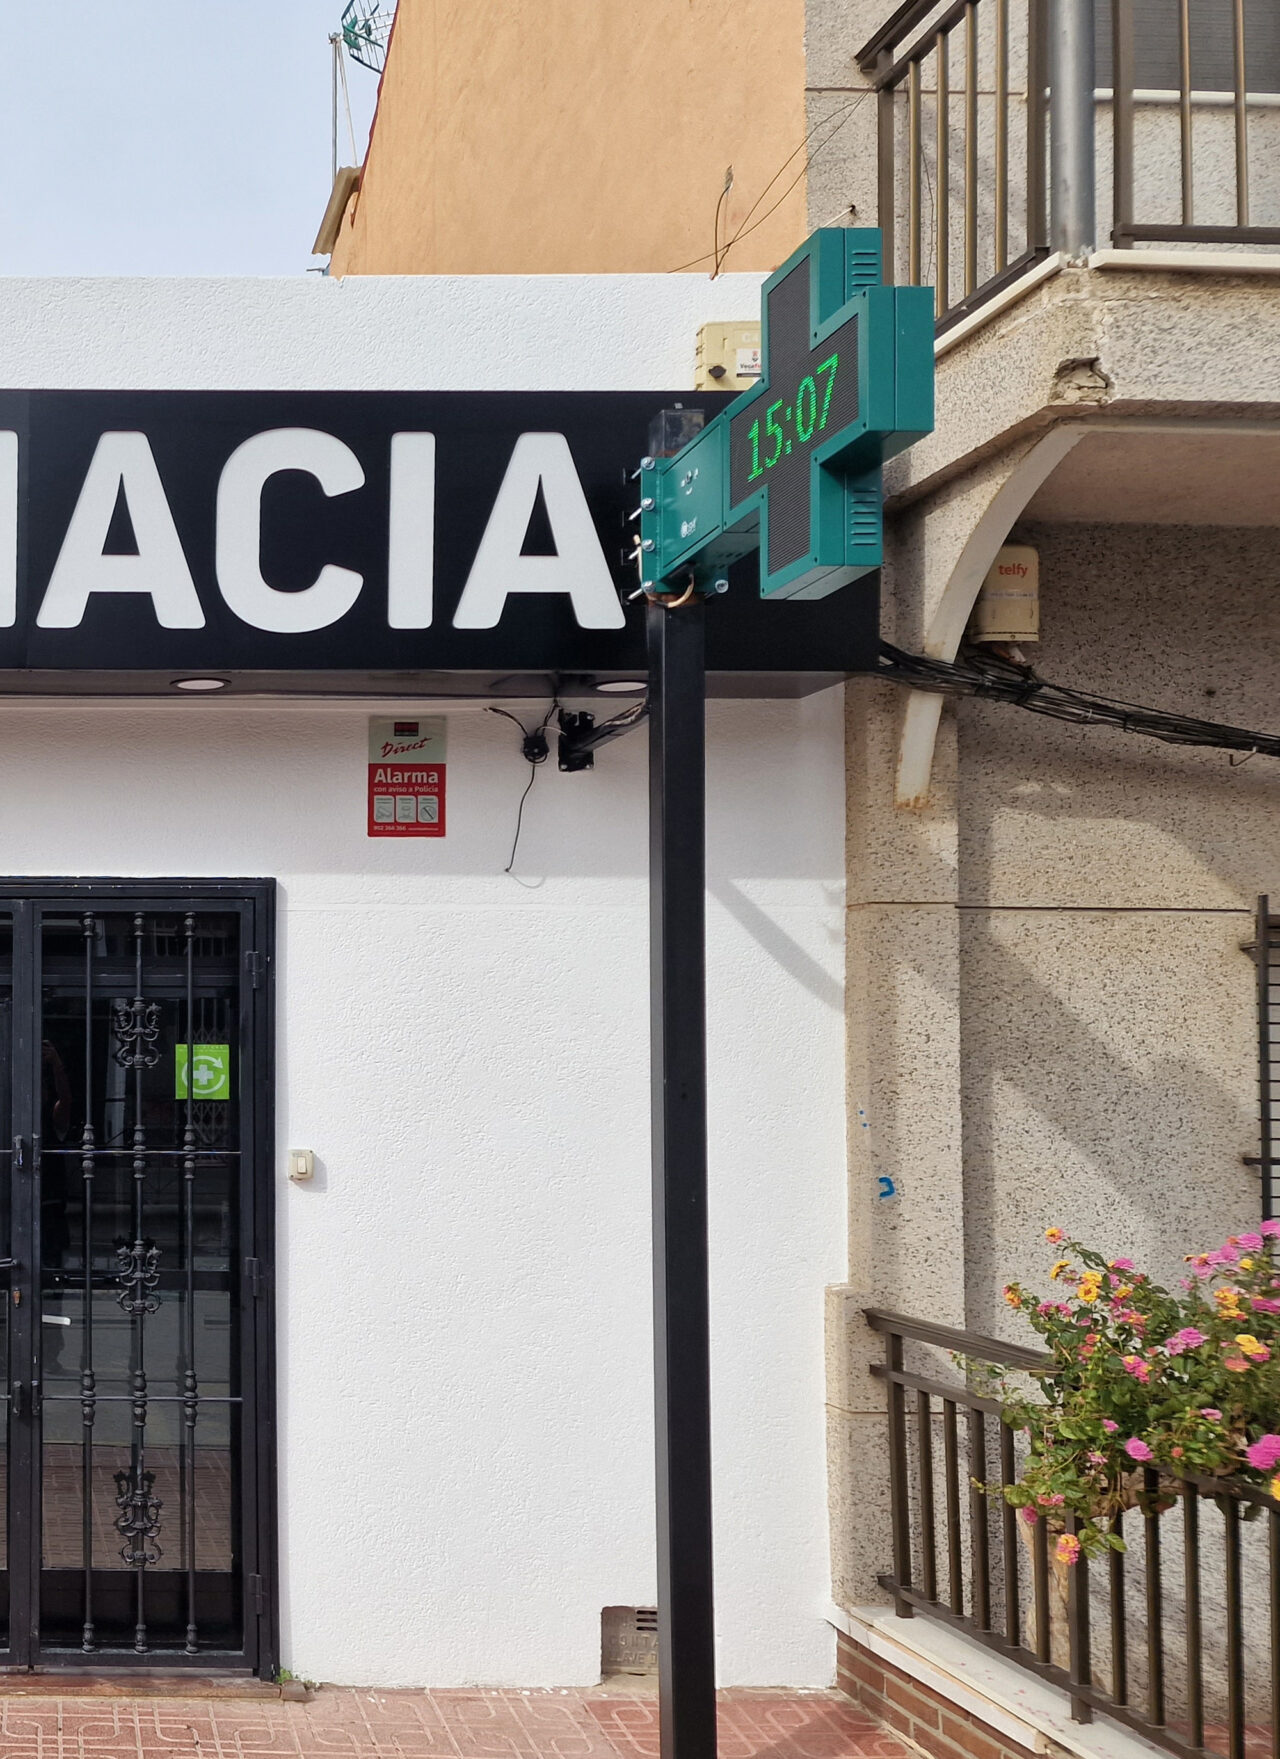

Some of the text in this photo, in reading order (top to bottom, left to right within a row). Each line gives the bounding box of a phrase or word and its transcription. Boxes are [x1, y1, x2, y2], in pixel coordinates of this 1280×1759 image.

[746, 353, 839, 483] 15:07
[998, 563, 1028, 578] telfy
[381, 737, 432, 758] Direct
[374, 767, 439, 784] Alarma
[388, 785, 407, 793] aviso
